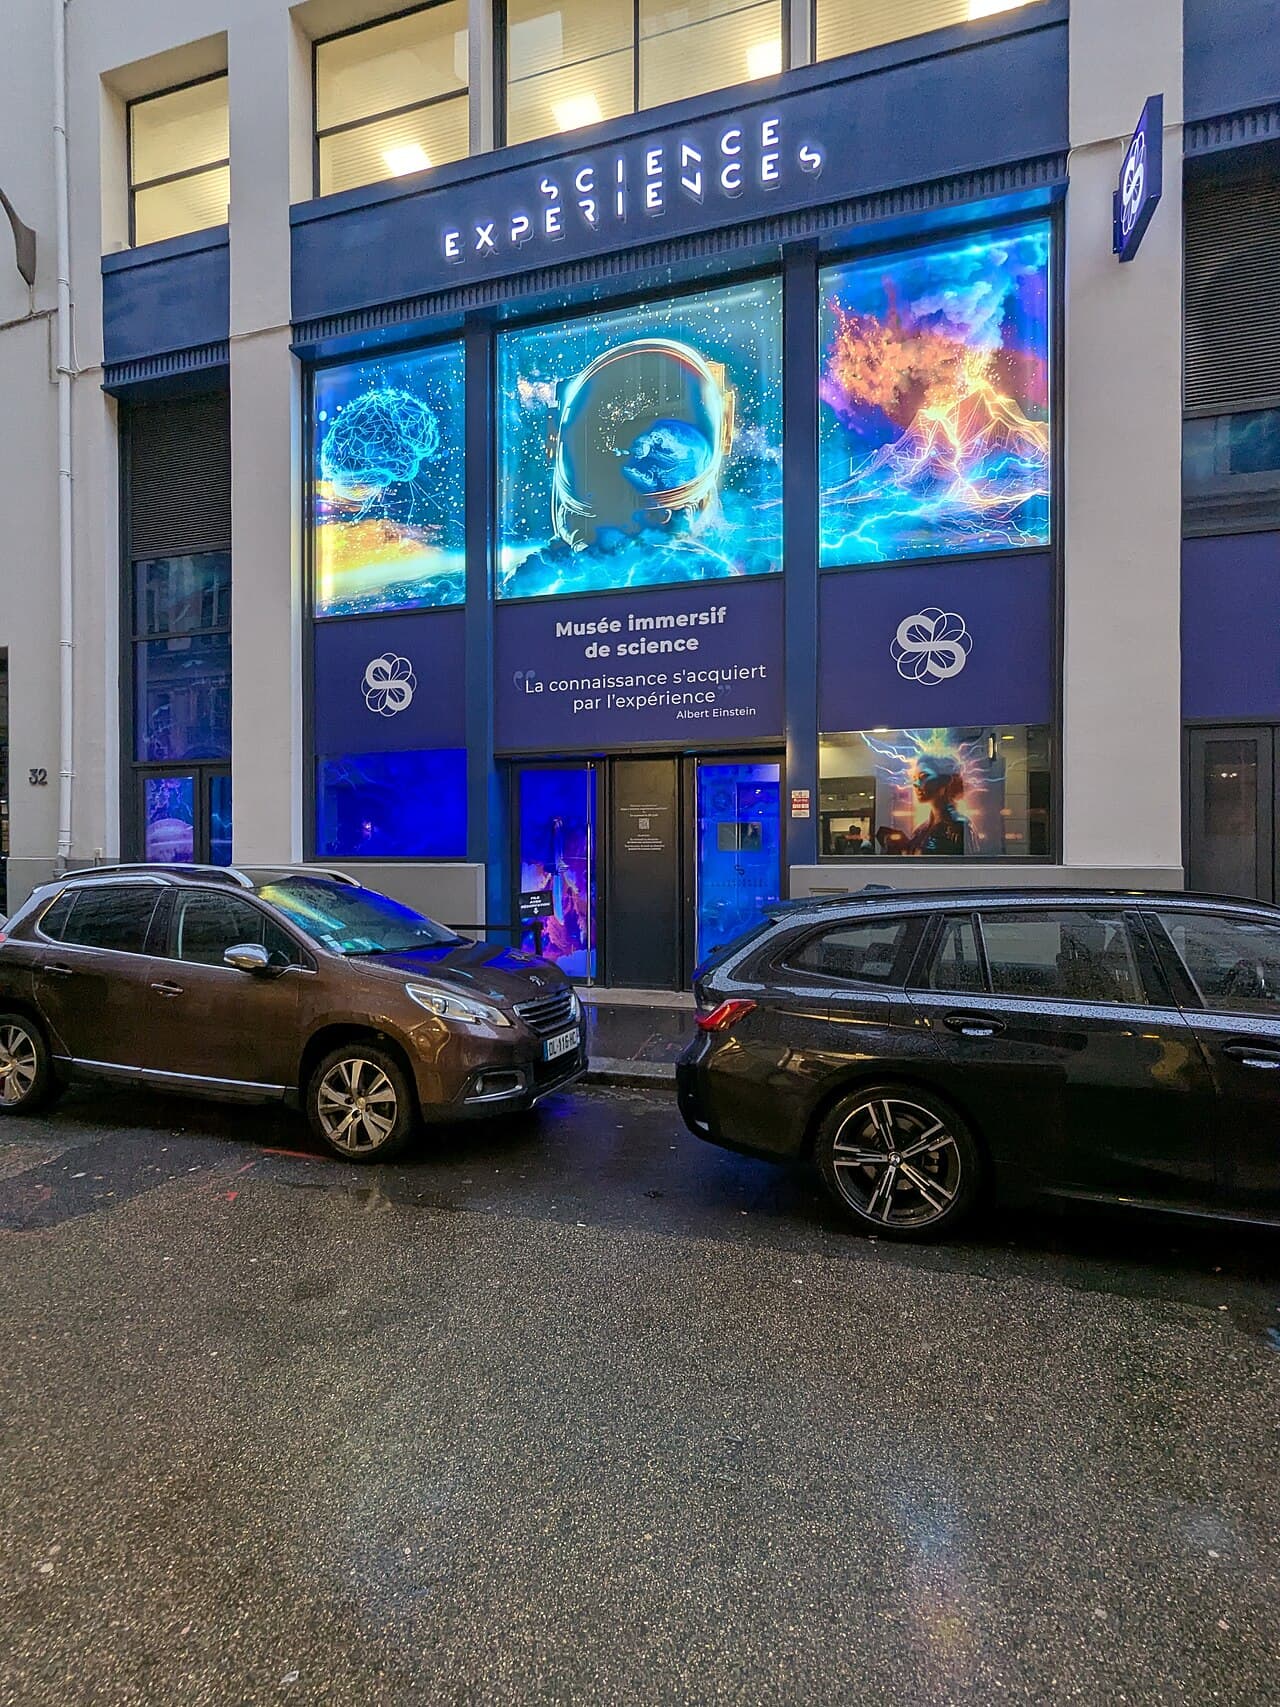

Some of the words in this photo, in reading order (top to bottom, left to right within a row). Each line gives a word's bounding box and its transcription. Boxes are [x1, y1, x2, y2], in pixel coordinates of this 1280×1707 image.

[555, 617, 622, 638] Musée
[627, 606, 728, 632] immersif
[584, 641, 611, 659] de
[616, 637, 700, 657] science
[548, 673, 668, 692] connaissance
[672, 664, 767, 685] s'acquiert
[573, 698, 602, 714] par
[676, 709, 710, 719] Albert
[712, 706, 757, 718] Einstein
[28, 768, 49, 786] 32
